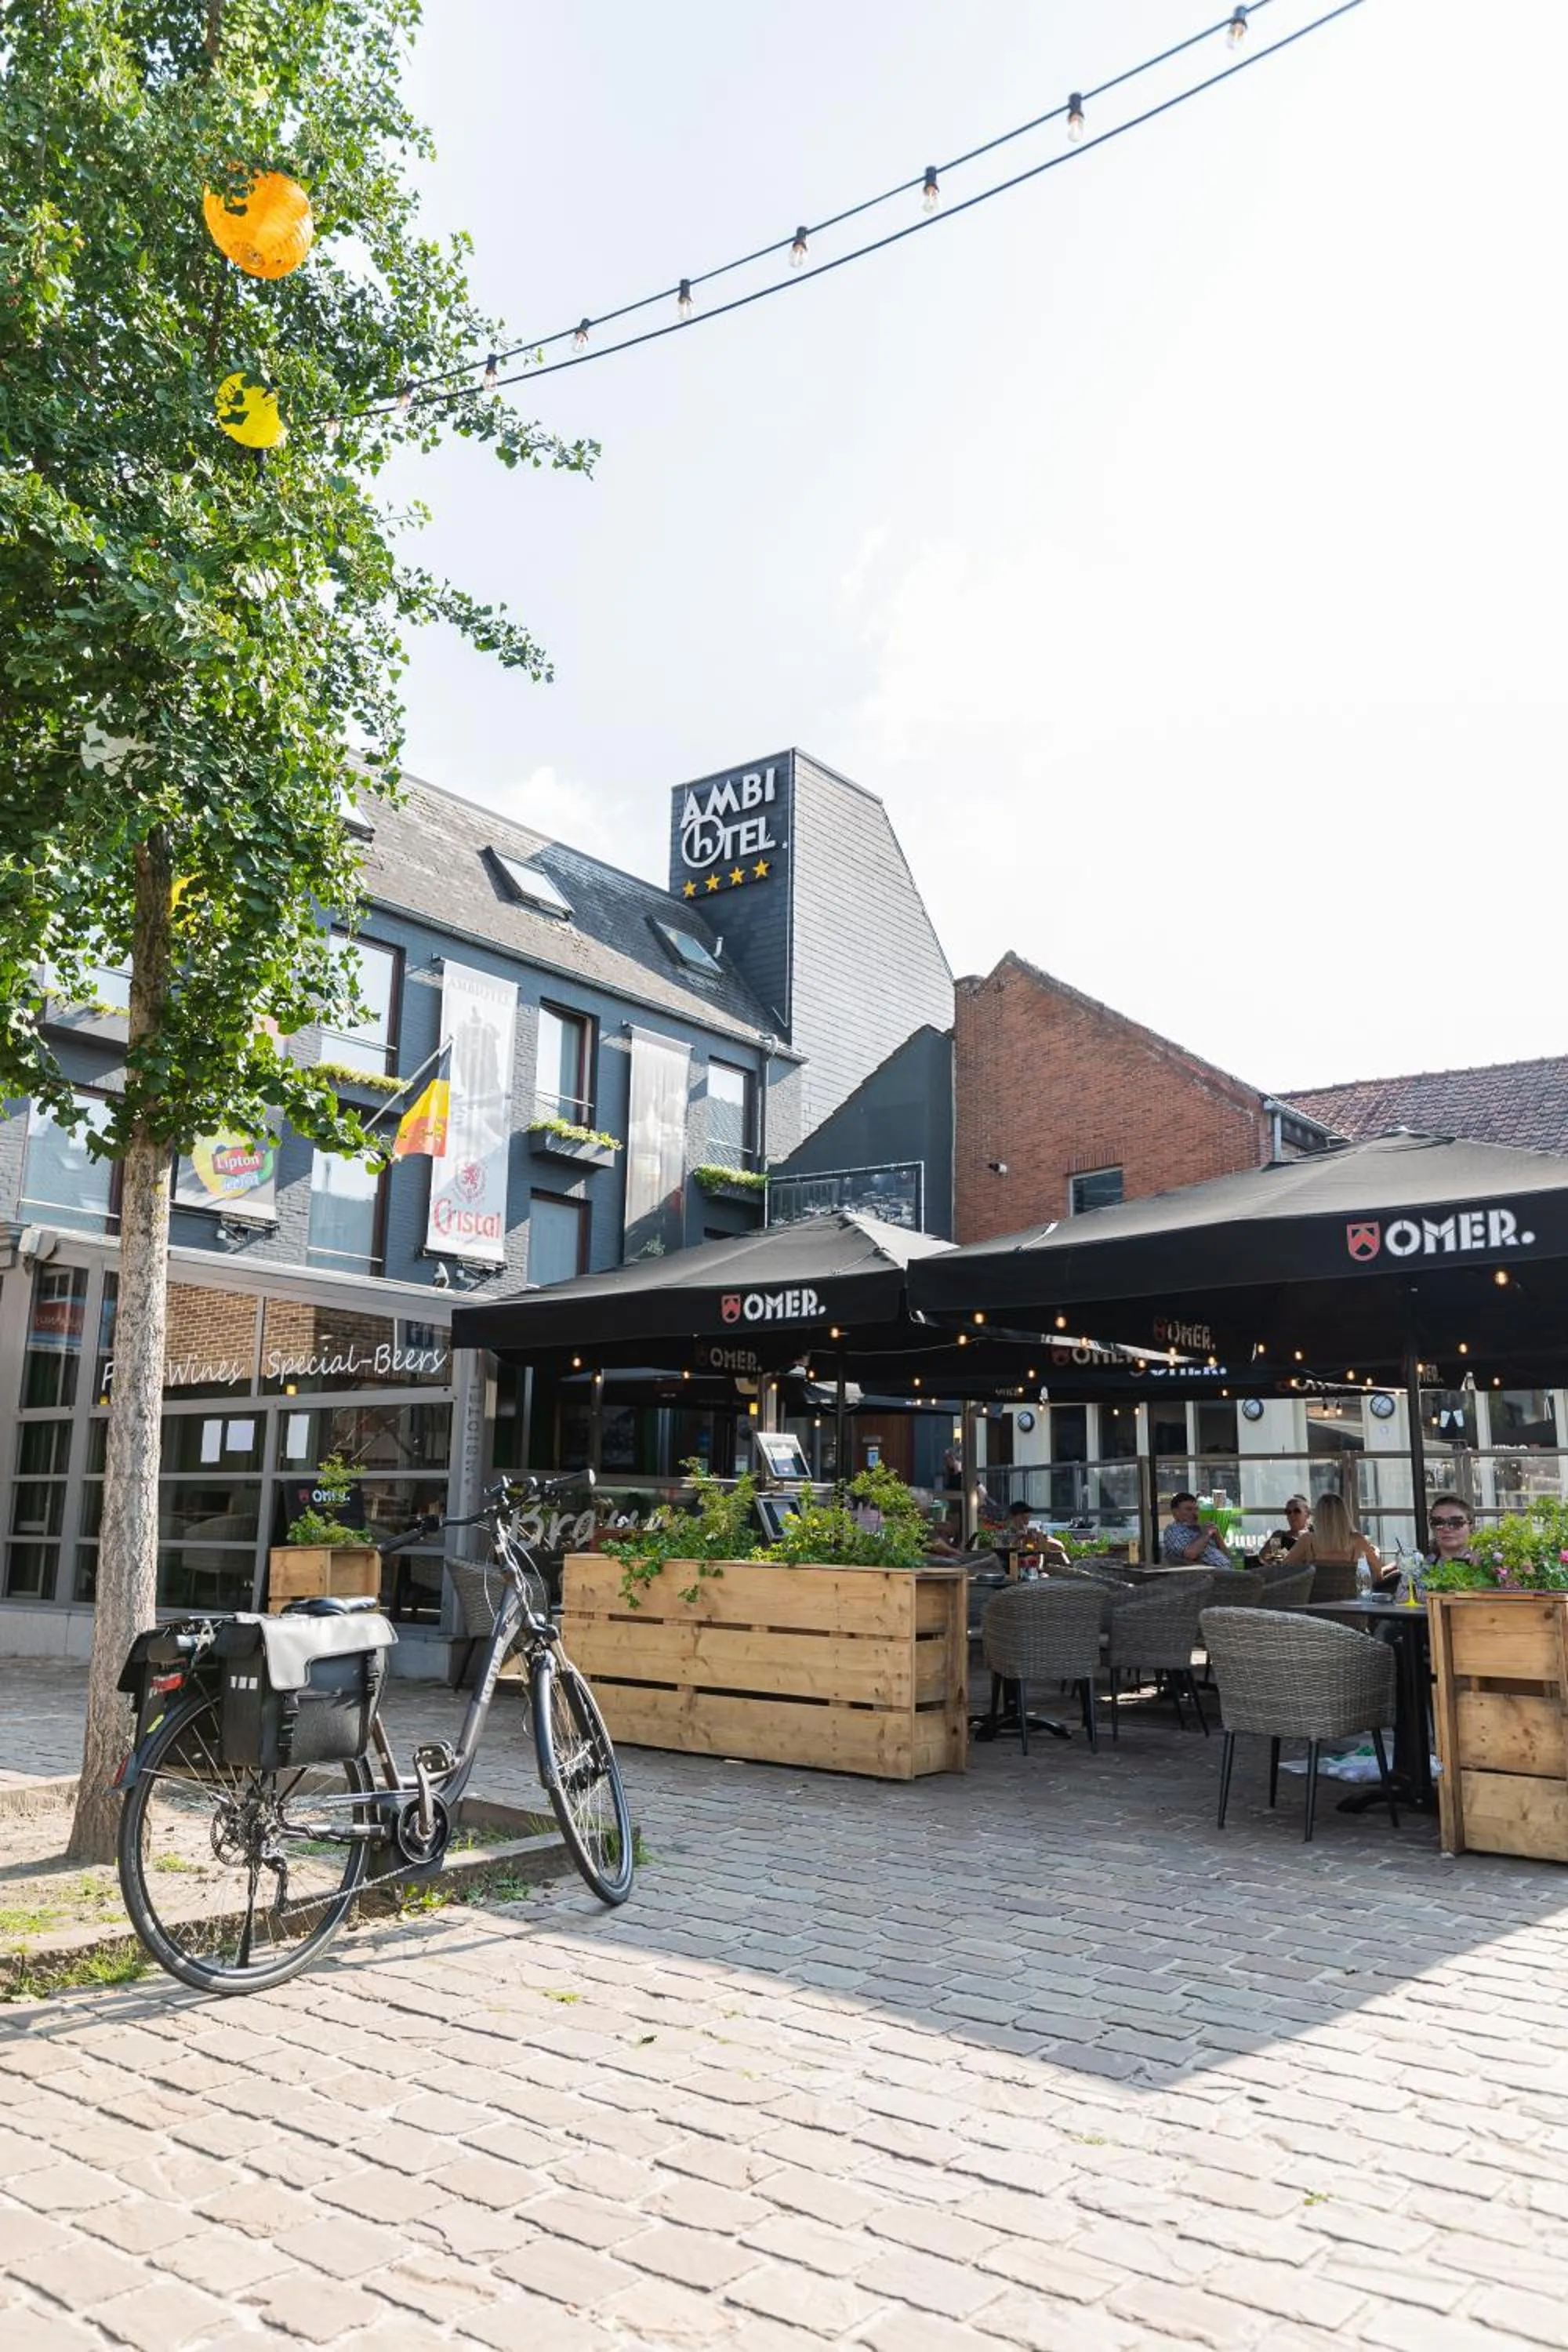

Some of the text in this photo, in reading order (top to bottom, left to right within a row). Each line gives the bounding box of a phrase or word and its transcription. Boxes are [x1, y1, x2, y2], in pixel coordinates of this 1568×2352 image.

[680, 768, 775, 829] AMBI
[216, 1153, 260, 1171] Lipton
[434, 1197, 502, 1239] Cristal
[266, 1343, 448, 1385] Special-Beers
